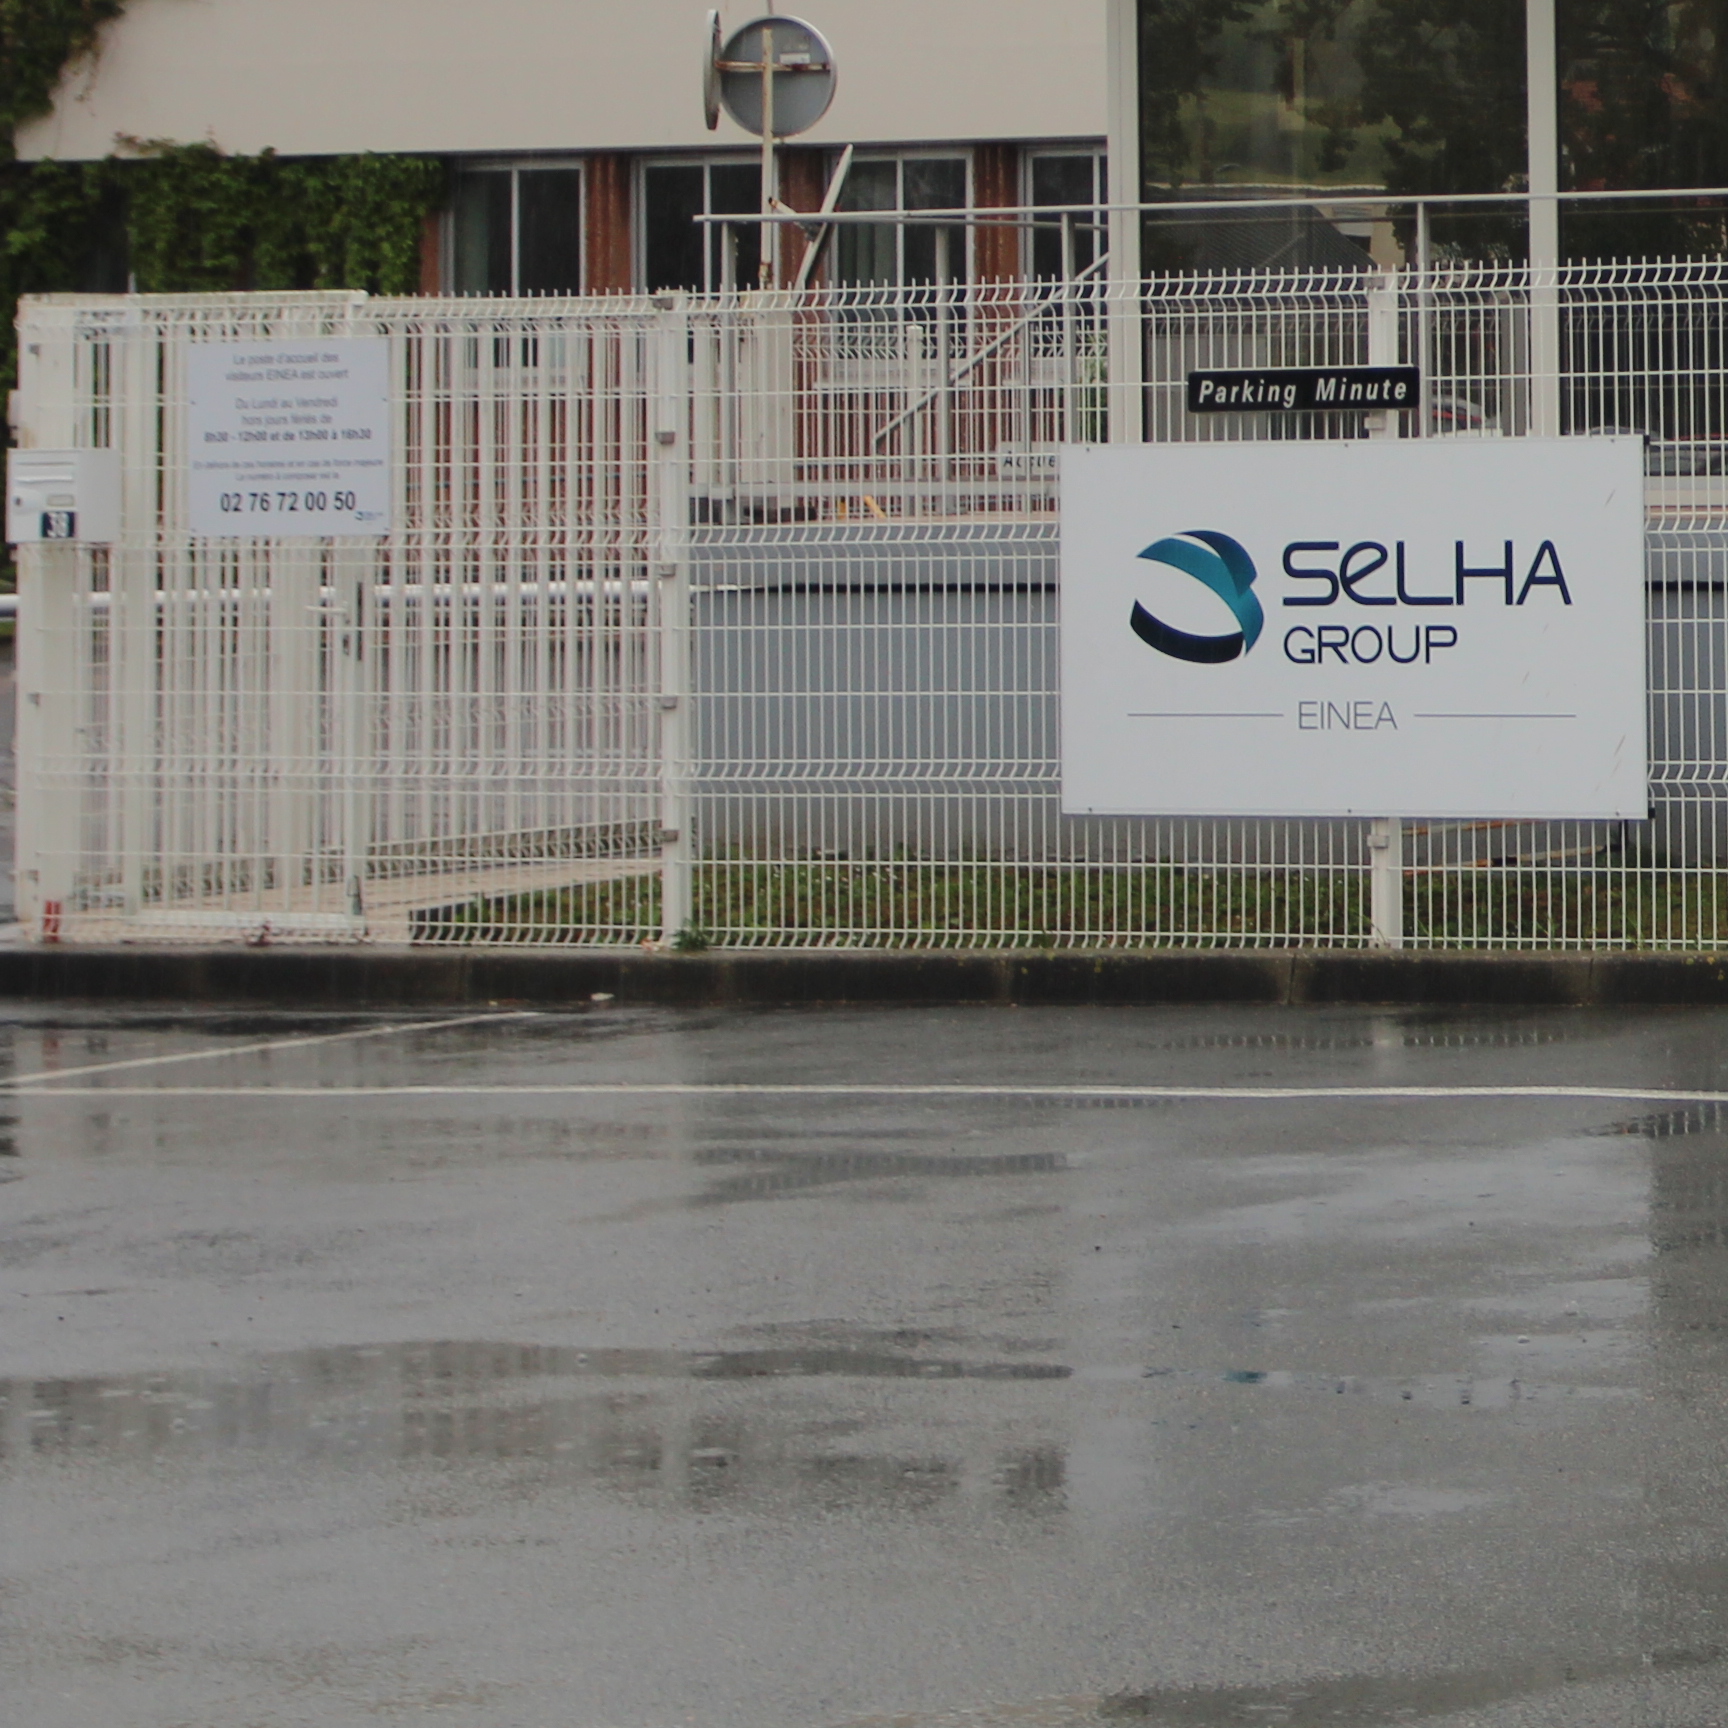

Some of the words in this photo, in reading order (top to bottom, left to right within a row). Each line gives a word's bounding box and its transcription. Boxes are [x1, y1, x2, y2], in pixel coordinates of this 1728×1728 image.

[1198, 379, 1297, 409] Parking
[1315, 377, 1407, 401] Minute
[220, 492, 242, 512] 02
[248, 491, 270, 512] 76
[276, 491, 299, 511] 72
[304, 491, 327, 511] 00
[333, 490, 356, 511] 50
[1283, 625, 1458, 665] GROUP
[1298, 701, 1398, 730] EINEA
